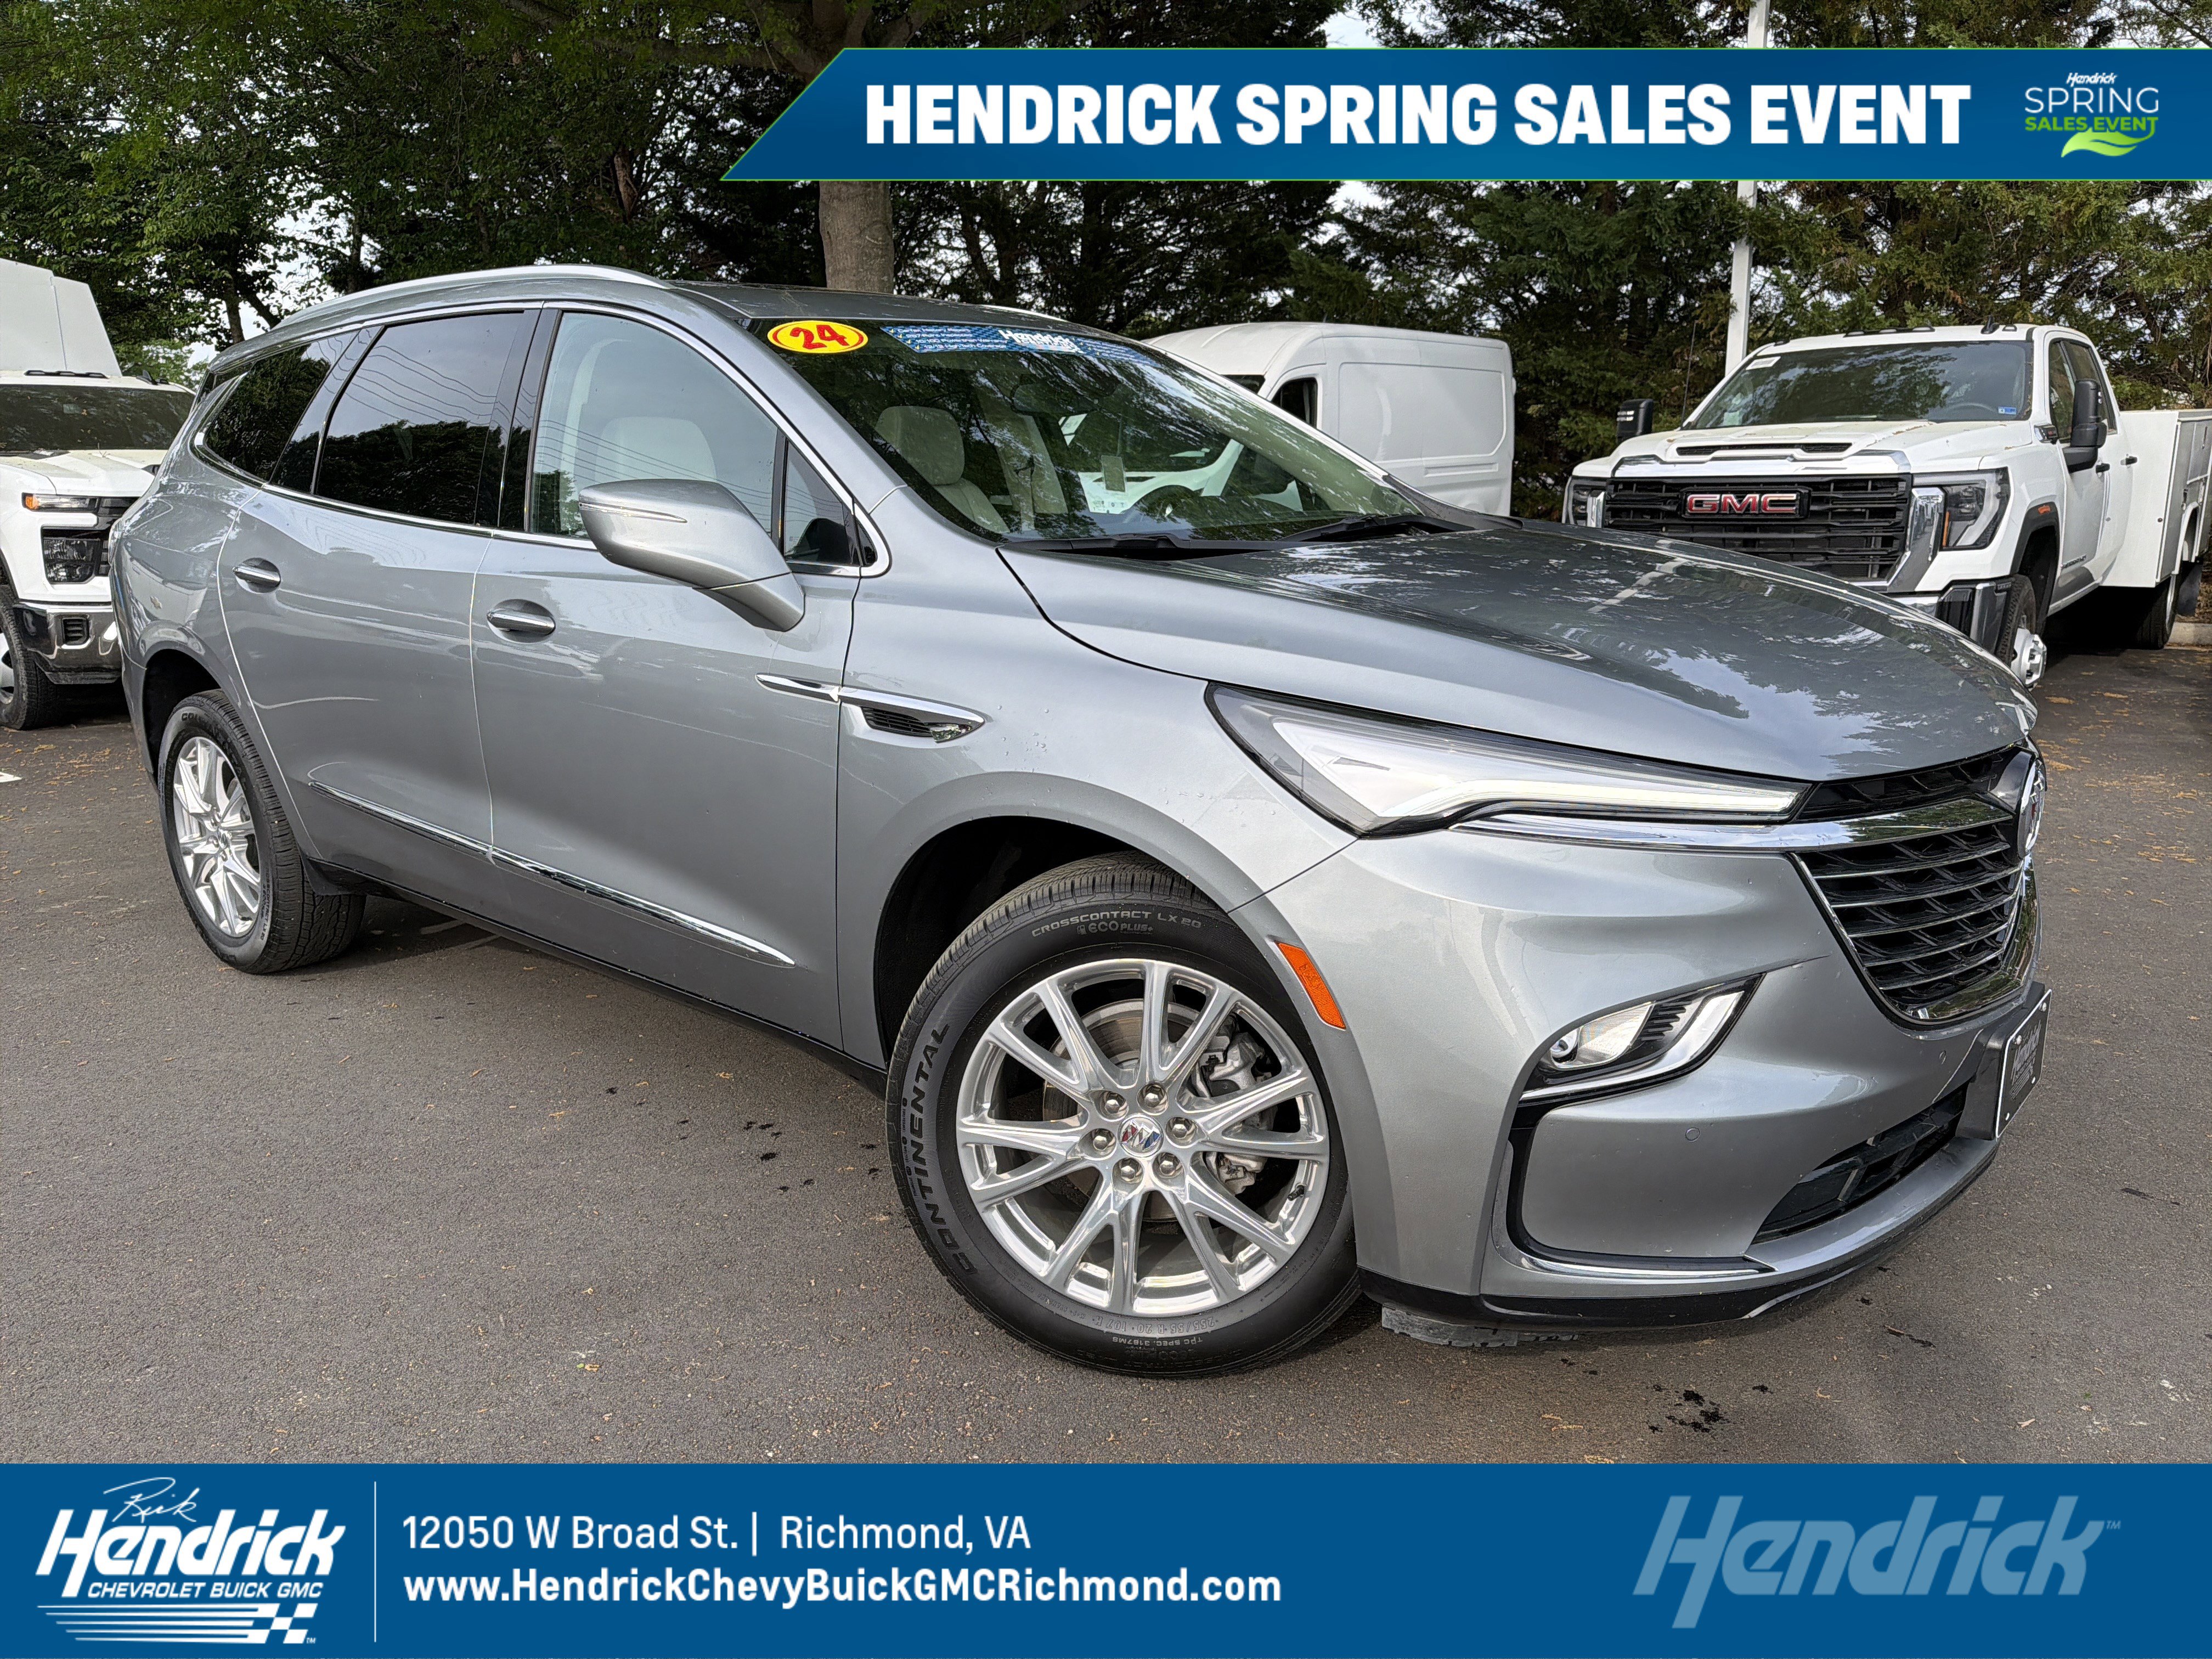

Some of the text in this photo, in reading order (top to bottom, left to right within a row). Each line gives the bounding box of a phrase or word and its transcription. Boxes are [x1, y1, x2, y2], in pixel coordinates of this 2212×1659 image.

[789, 324, 850, 349] 24
[1687, 494, 1797, 514] GMC
[1031, 910, 1202, 938] CROSSCONTACT LX 20
[910, 1023, 978, 1274] CONTINENTAL
